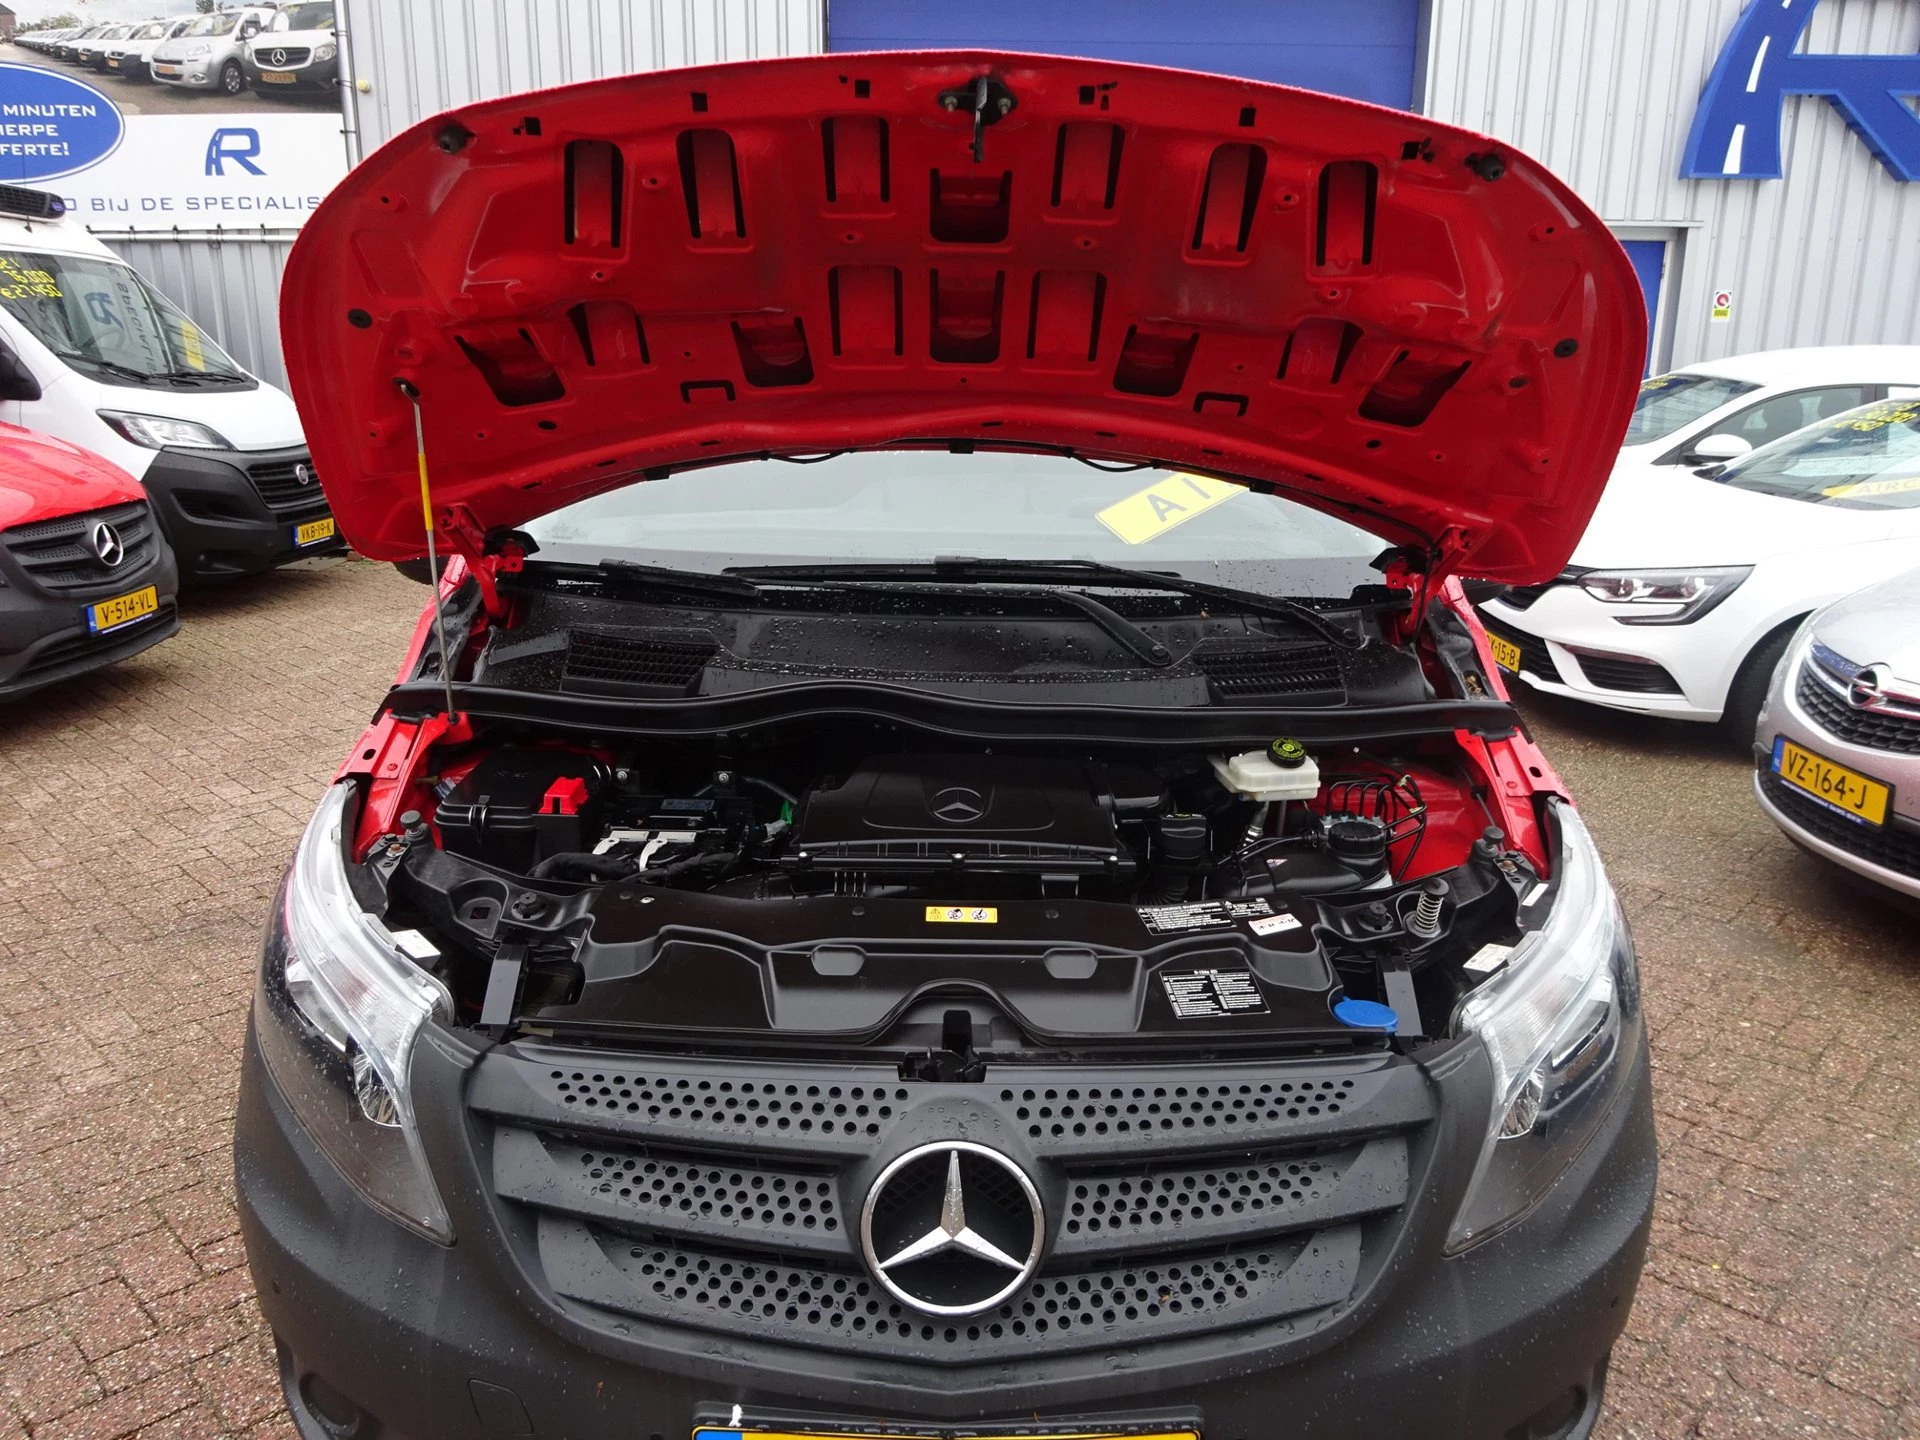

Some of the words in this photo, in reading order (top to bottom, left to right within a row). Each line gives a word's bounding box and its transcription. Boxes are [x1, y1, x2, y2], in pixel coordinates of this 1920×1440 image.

[3, 104, 97, 117] MINUTEN
[0, 141, 70, 156] FERTE!
[205, 127, 268, 176] R
[91, 198, 129, 211] BIJ
[141, 197, 174, 211] DE
[186, 196, 324, 210] SPECIALIS
[101, 592, 153, 624] V-514-VL
[1788, 748, 1867, 809] VZ-164-J
